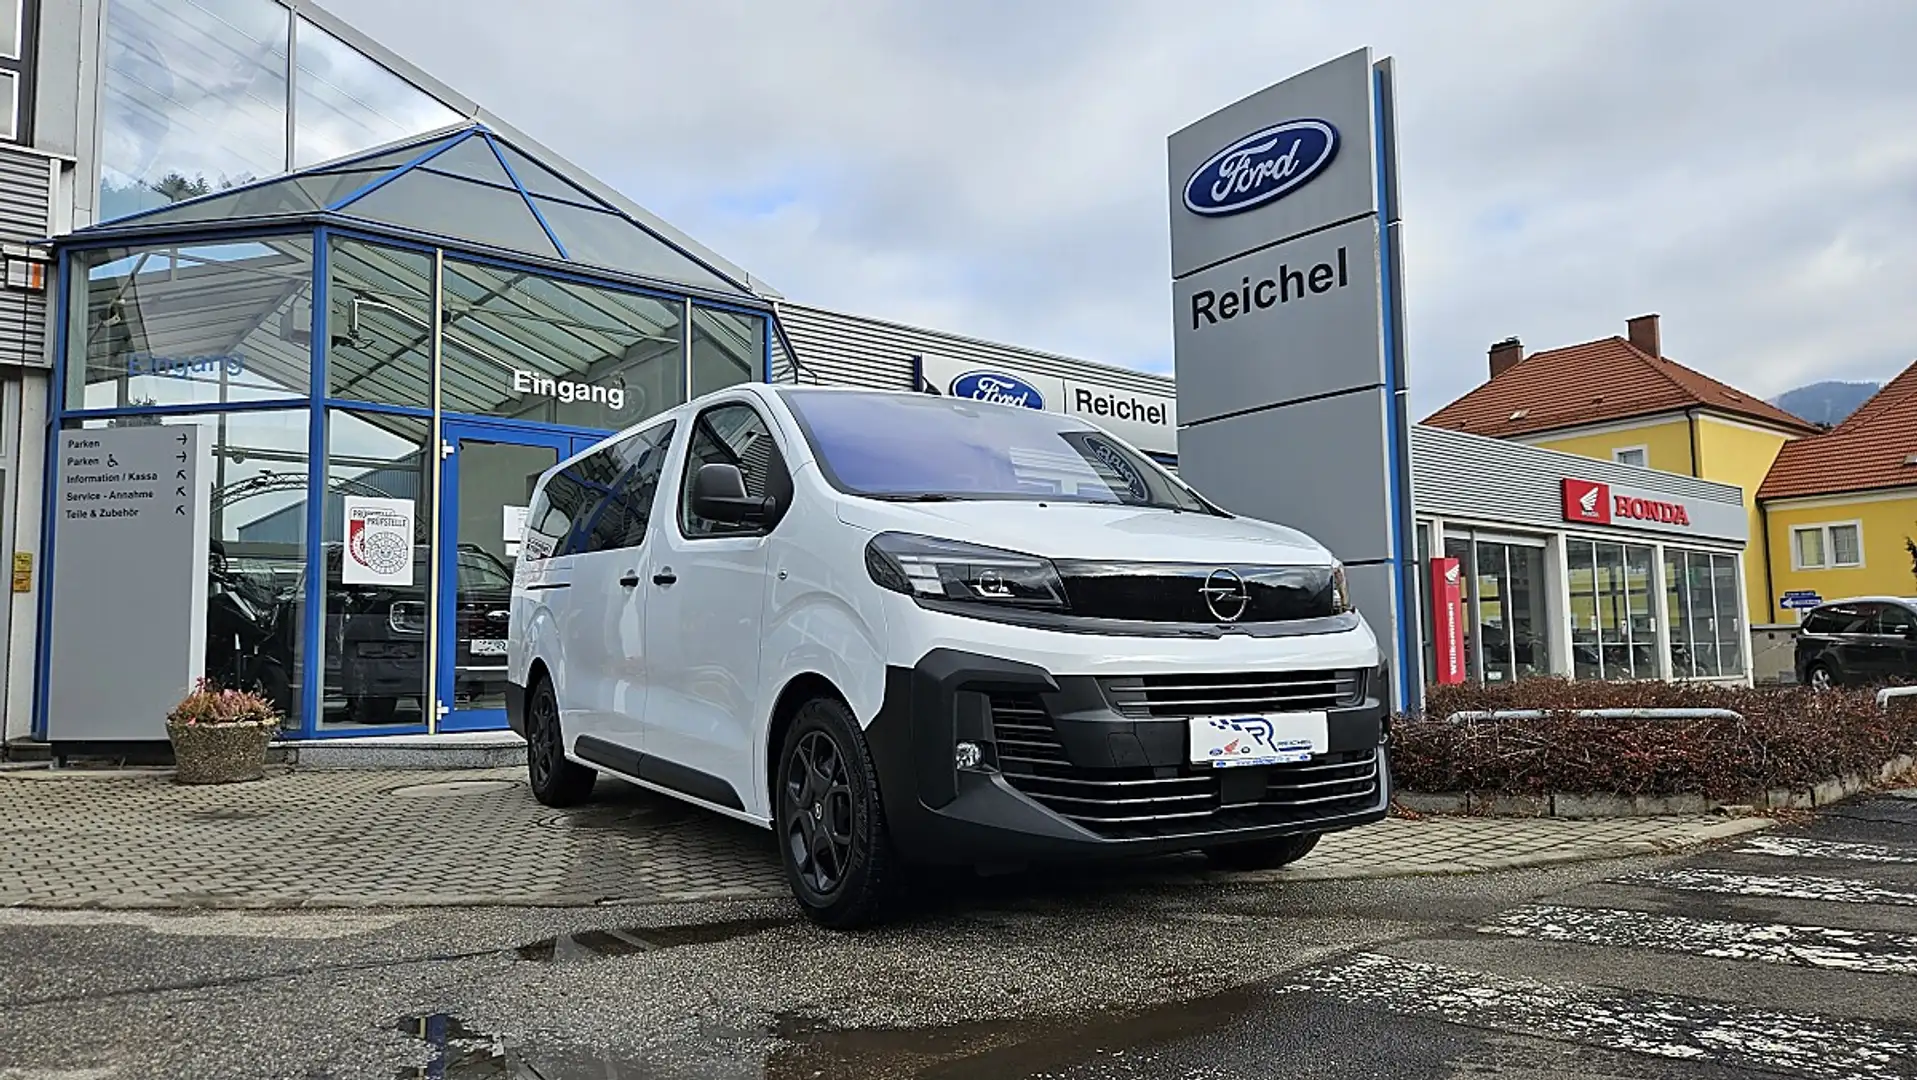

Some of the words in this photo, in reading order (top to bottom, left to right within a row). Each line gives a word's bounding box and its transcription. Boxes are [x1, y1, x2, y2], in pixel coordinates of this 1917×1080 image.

[1210, 137, 1302, 202] Ford
[1190, 246, 1348, 331] Reichel
[127, 352, 244, 377] Eingang
[514, 368, 625, 410] Eingang
[972, 376, 1030, 410] Ford
[1075, 388, 1168, 426] Reichel
[68, 439, 101, 449] Parken
[67, 457, 99, 467] Parken
[66, 473, 120, 484] Information
[127, 472, 158, 481] Kassa
[66, 491, 101, 502] Service
[108, 490, 154, 500] Annahme
[1614, 495, 1690, 525] HONDA
[65, 509, 88, 520] Teile
[89, 509, 98, 519] &
[99, 507, 139, 518] Zubehör
[1447, 602, 1458, 676] Willkommen
